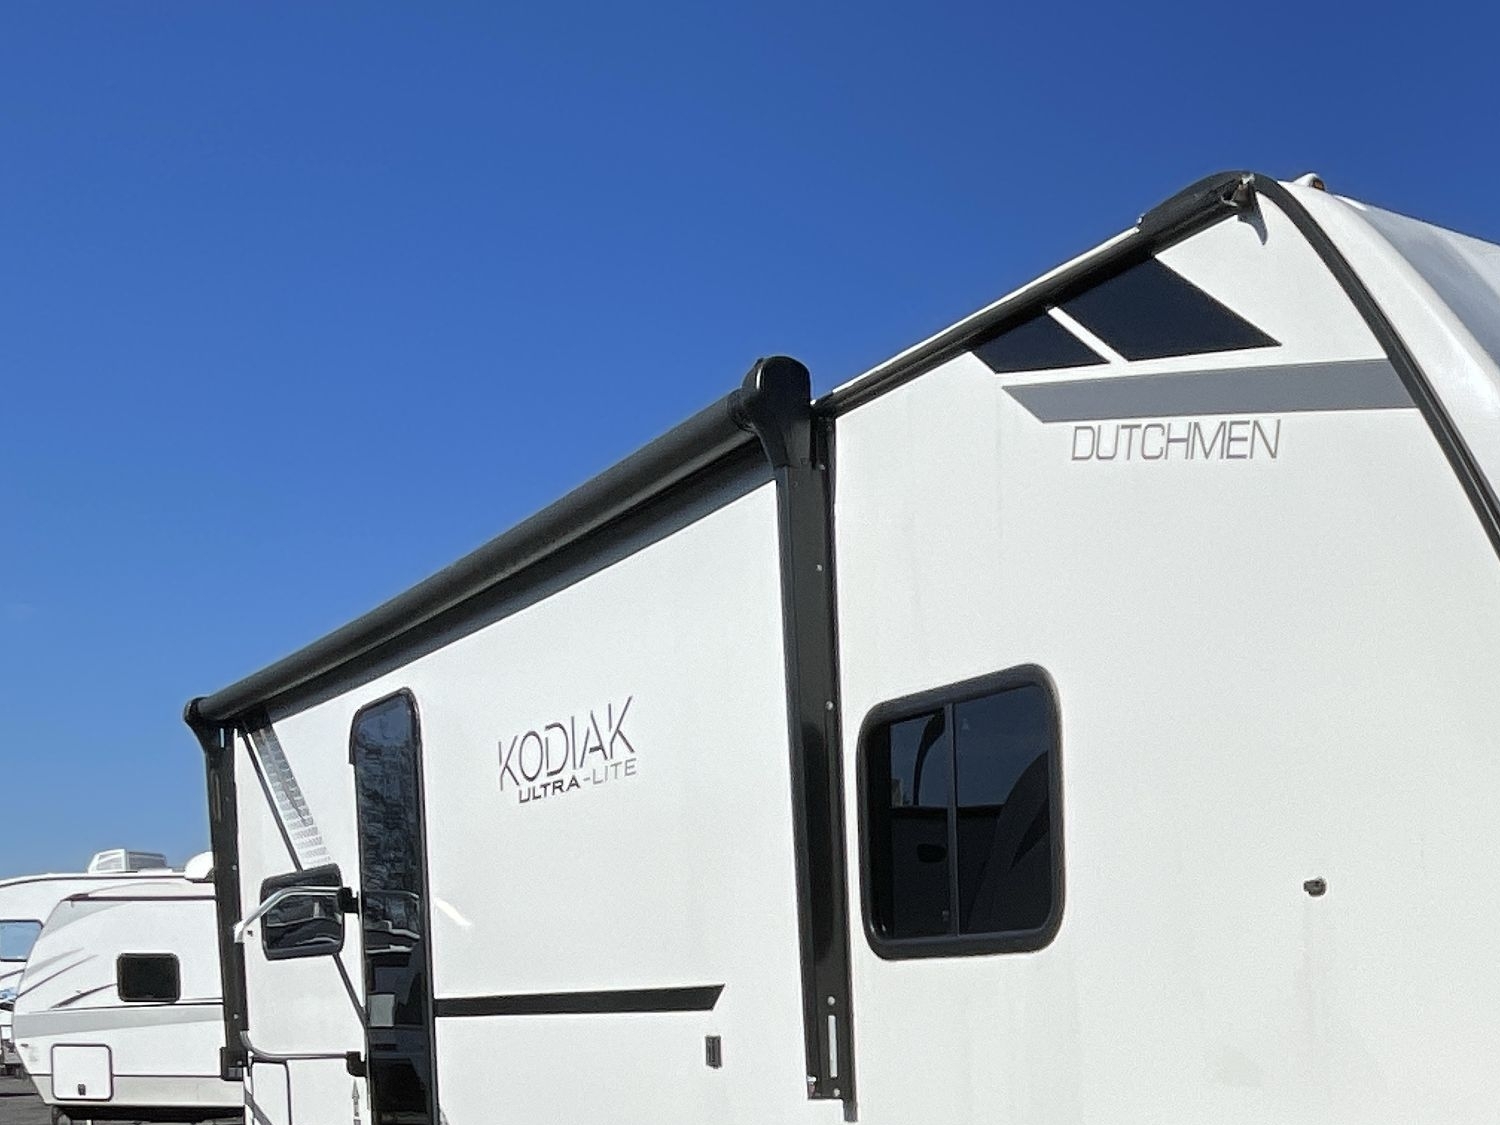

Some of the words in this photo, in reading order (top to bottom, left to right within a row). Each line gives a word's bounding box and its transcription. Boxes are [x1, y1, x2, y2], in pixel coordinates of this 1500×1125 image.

[1071, 419, 1281, 460] DUTCHMEN
[498, 695, 635, 792] KODIAK
[518, 757, 637, 804] ULTRA-LITE
